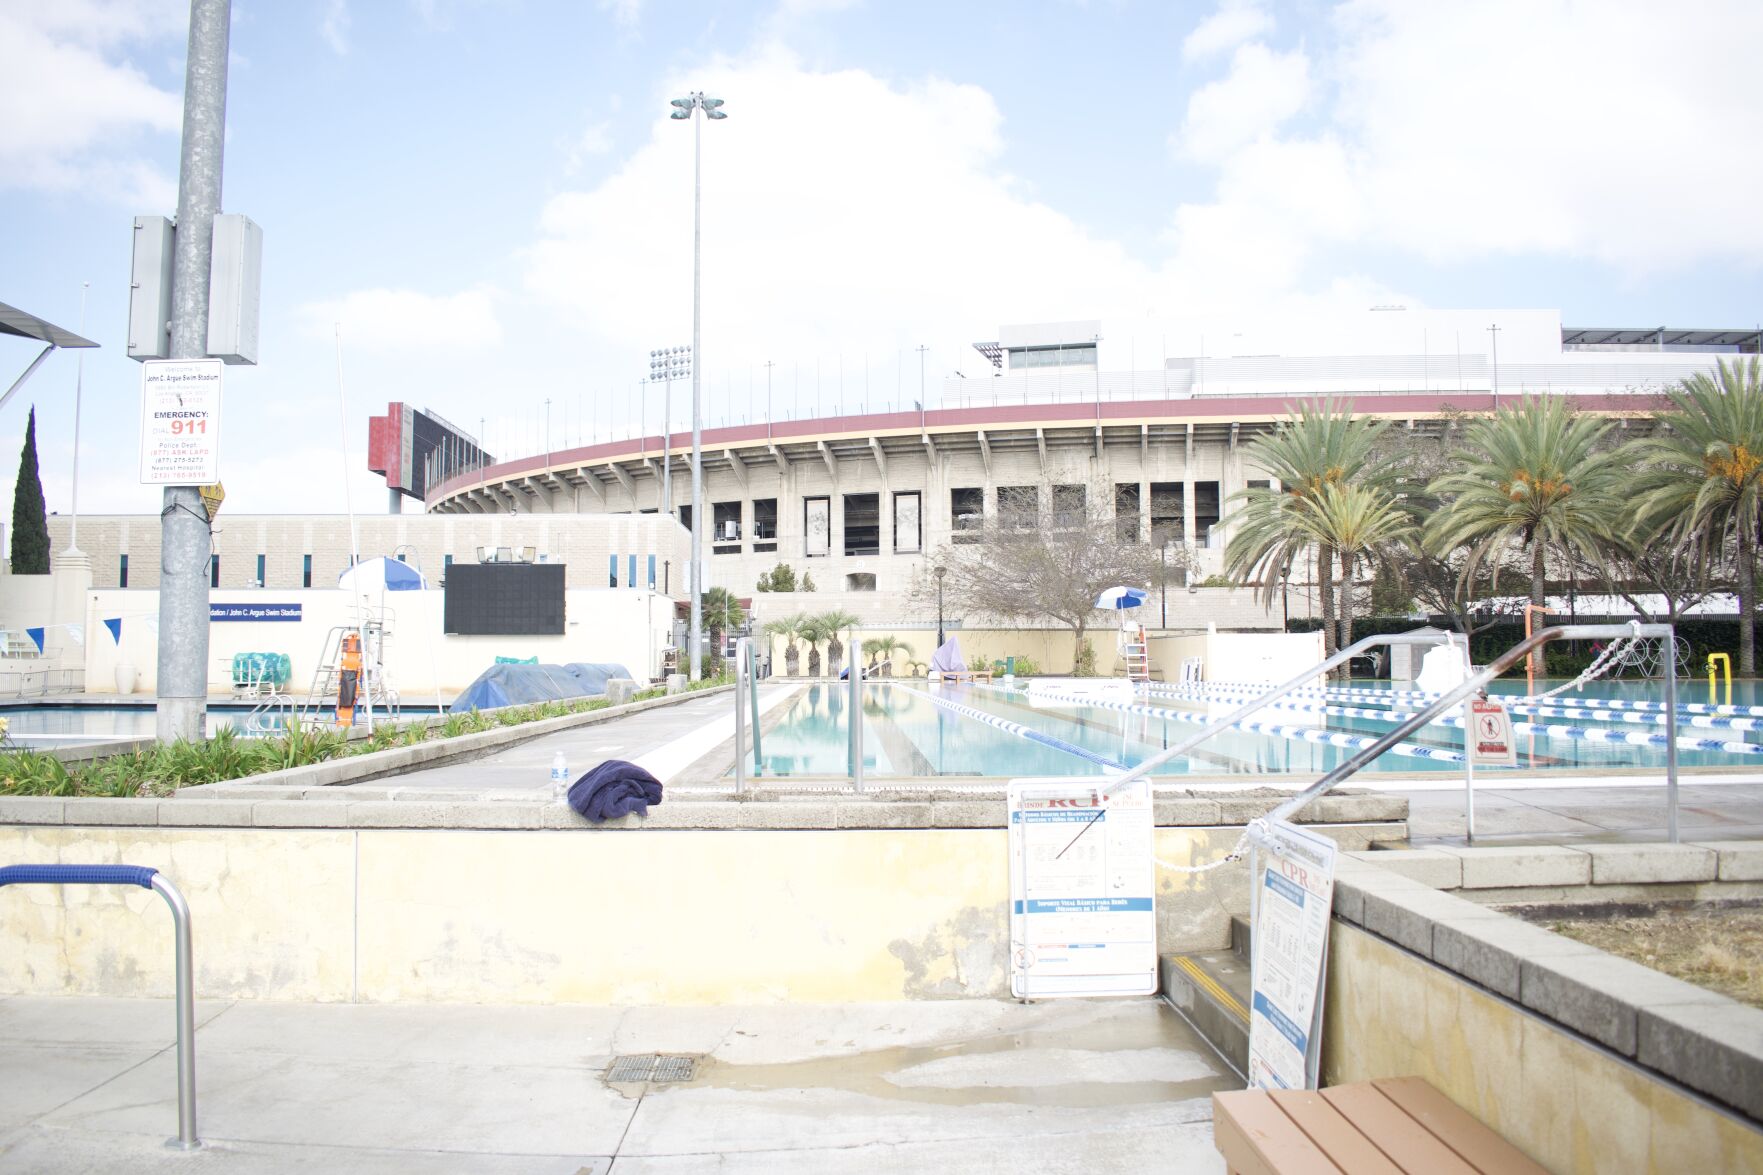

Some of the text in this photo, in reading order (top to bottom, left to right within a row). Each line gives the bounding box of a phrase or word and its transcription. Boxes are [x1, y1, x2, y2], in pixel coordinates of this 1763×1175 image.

[166, 374, 182, 383] Argue
[198, 373, 219, 381] Stadium
[154, 411, 209, 419] EMERGENCY:
[171, 419, 206, 435] 911
[229, 608, 242, 616] John
[242, 608, 249, 616] C.
[249, 608, 265, 618] Argue
[265, 608, 280, 616] Swim
[280, 608, 302, 616] Stadium
[1281, 859, 1309, 888] CPR
